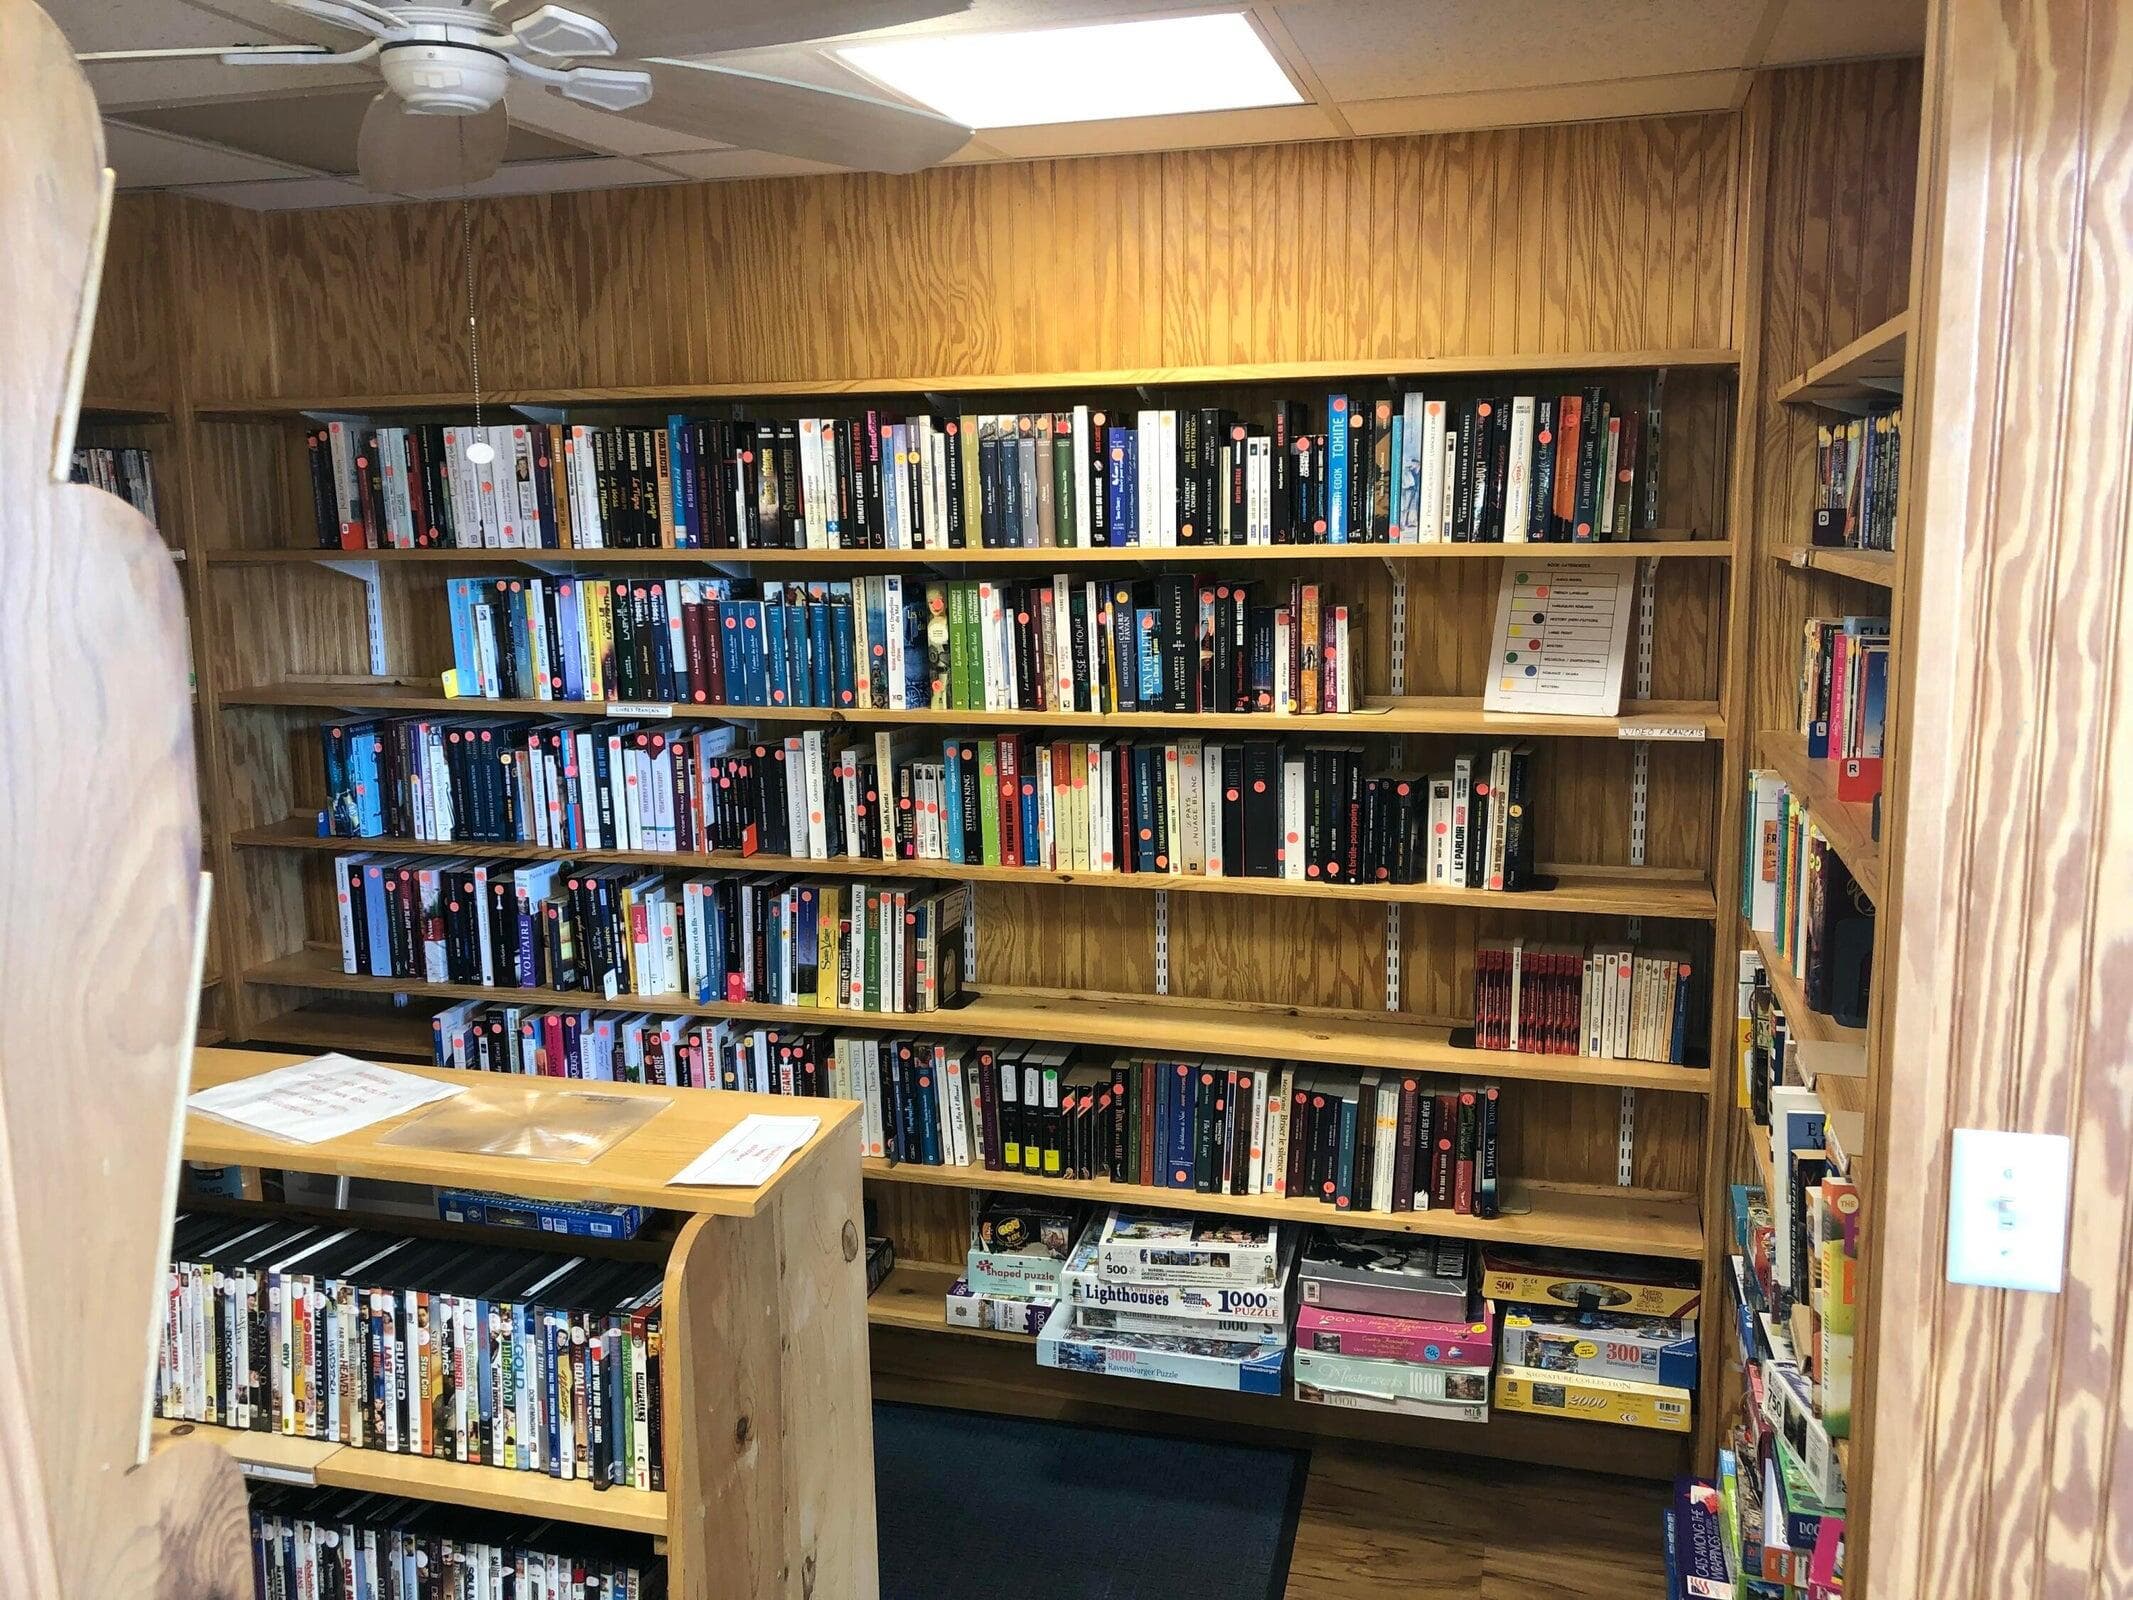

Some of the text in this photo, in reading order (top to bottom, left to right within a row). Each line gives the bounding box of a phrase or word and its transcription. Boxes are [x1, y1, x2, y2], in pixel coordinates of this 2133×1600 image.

[658, 432, 668, 477] BORNICHE
[1333, 418, 1344, 489] COOK TOXINE
[856, 472, 864, 498] CARRISI
[1583, 468, 1591, 479] du
[1183, 478, 1191, 510] PRÉSIDENT
[857, 500, 865, 524] DONATO
[1820, 512, 1828, 524] D
[1141, 629, 1153, 694] KEN FOLLETT
[1817, 723, 1825, 734] L
[1849, 763, 1857, 773] R
[602, 810, 611, 824] JACK
[883, 815, 891, 833] Judith
[1455, 826, 1465, 869] LE PARLOIR
[520, 920, 532, 977] VOLTAIRE
[705, 1028, 715, 1082] SAN-ANTONIO
[1486, 1139, 1495, 1167] SHACK
[1790, 1179, 1799, 1217] JEFFREY
[1840, 1200, 1855, 1208] THE
[1104, 1252, 1112, 1262] 4
[1106, 1265, 1128, 1275] 500
[986, 1269, 1055, 1280] shaped puzzle
[1495, 1280, 1514, 1291] 500
[1086, 1284, 1169, 1306] Lighthouses
[1217, 1290, 1268, 1313] 1000
[1233, 1307, 1279, 1318] PUZZLE
[1218, 1321, 1248, 1332] 1000
[171, 1343, 179, 1372] JURY
[225, 1316, 233, 1390] UNDISCOVERED
[259, 1311, 267, 1385] GODSEND
[281, 1343, 291, 1369] envy
[372, 1334, 381, 1377] ANTITRUST
[442, 1346, 450, 1376] lyrics
[1108, 1349, 1136, 1363] 3000
[1606, 1342, 1640, 1364] 300
[339, 1360, 348, 1397] HEAVEN
[395, 1341, 405, 1400] BURIED
[420, 1356, 430, 1399] Stay Cool
[514, 1344, 524, 1390] GOLD
[574, 1363, 585, 1395] GOAL!
[1108, 1363, 1178, 1379] Ravensburger Puzzle
[316, 1389, 323, 1397] 2
[592, 1377, 601, 1405] YOU FOR
[1409, 1371, 1442, 1394] 1000
[1526, 1371, 1631, 1390] SIGNATURE COLLECTION
[1568, 1395, 1608, 1409] 2000
[1768, 1389, 1782, 1418] 750
[637, 1472, 644, 1487] 1
[1692, 1509, 1709, 1578] CATS AMONG THE
